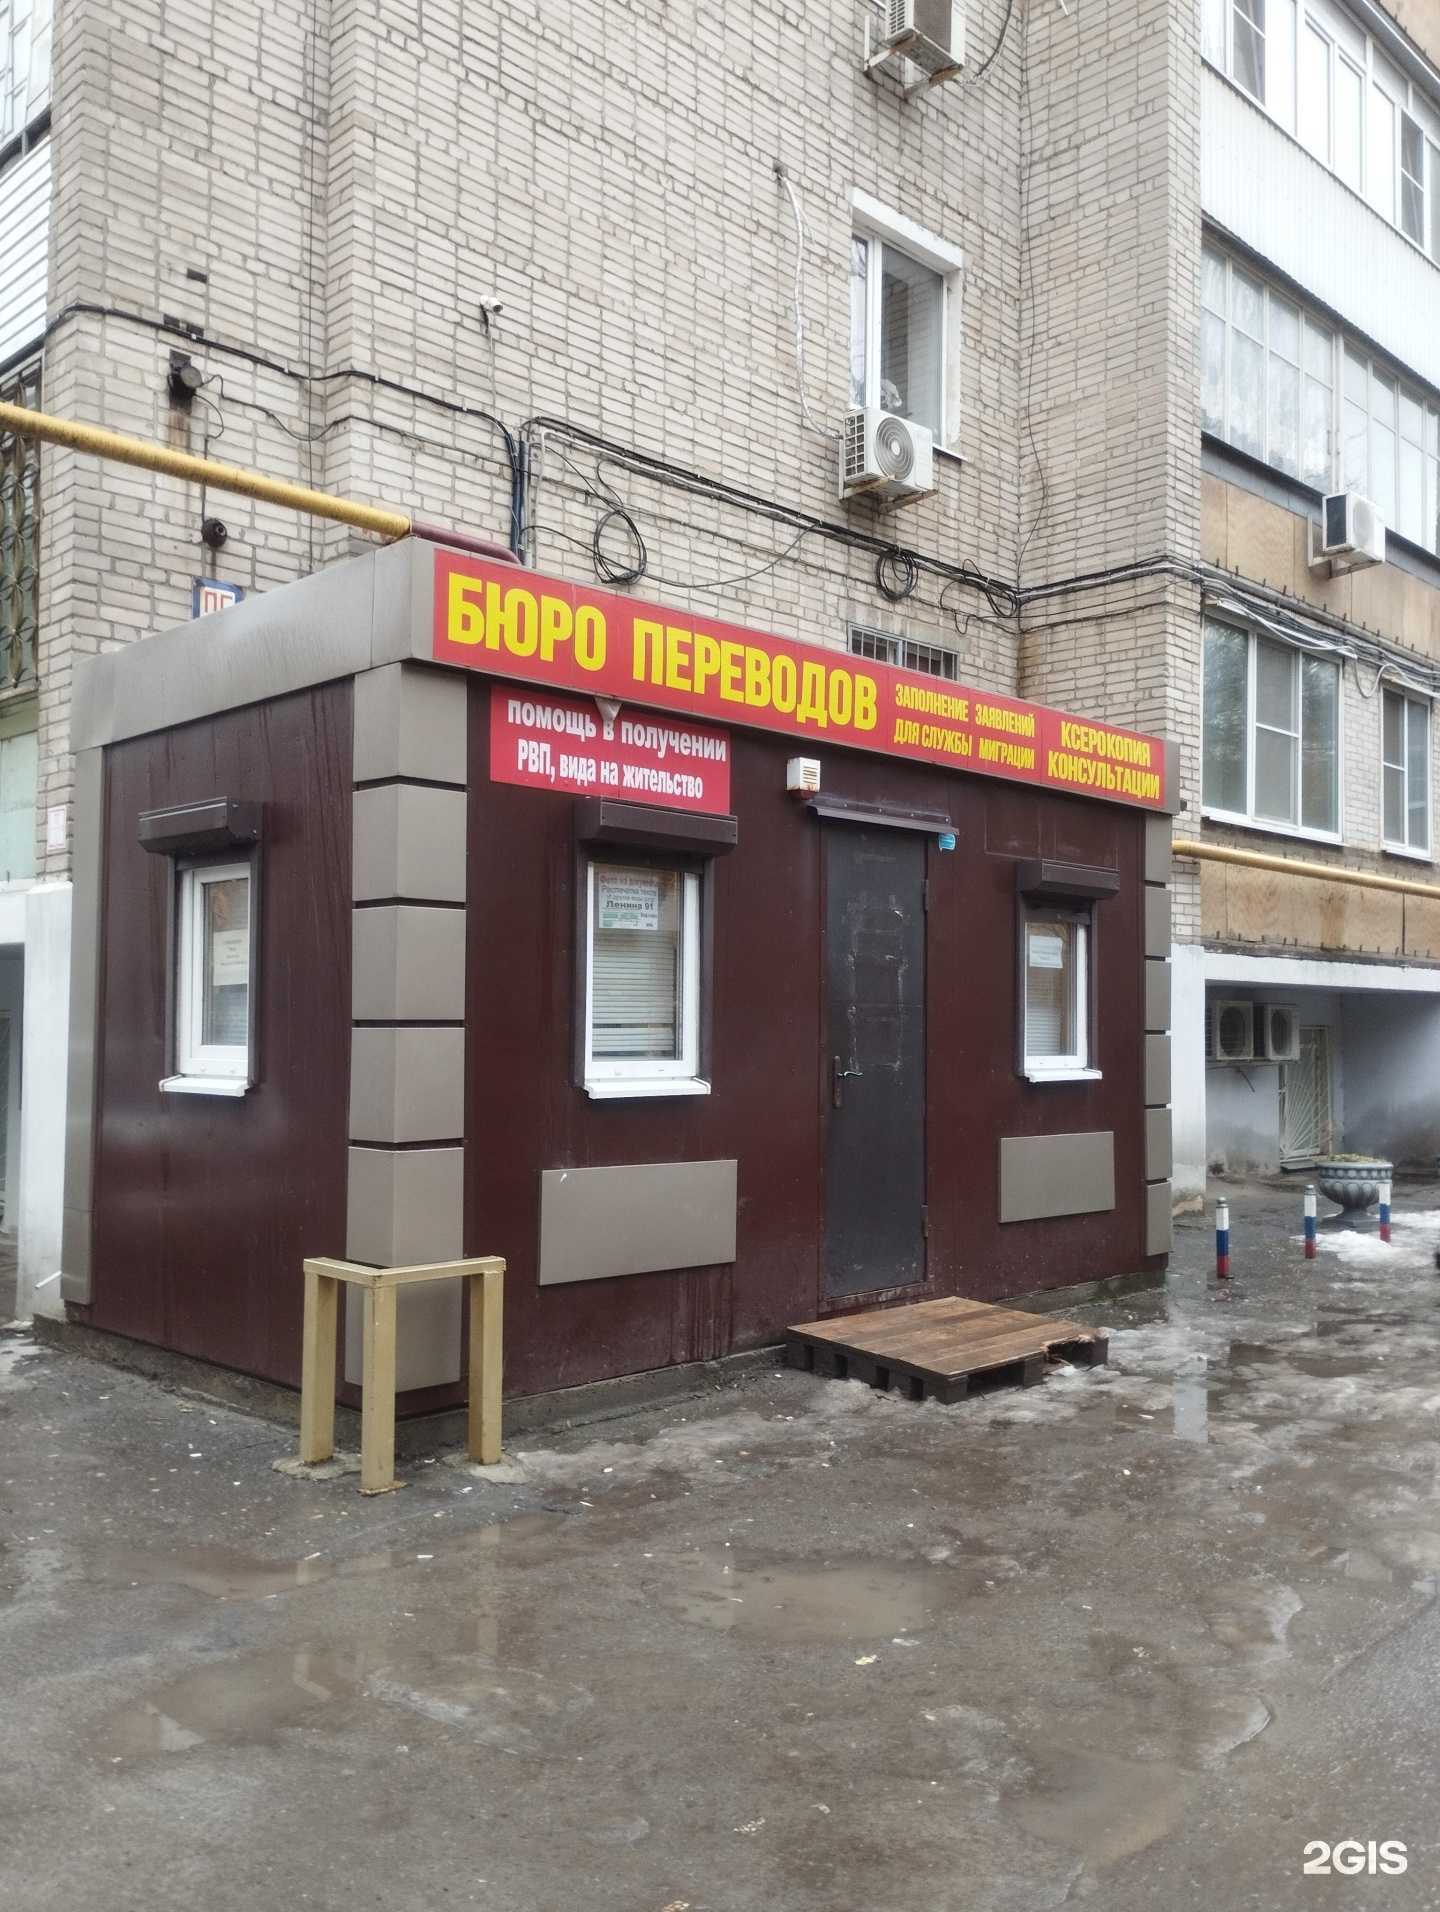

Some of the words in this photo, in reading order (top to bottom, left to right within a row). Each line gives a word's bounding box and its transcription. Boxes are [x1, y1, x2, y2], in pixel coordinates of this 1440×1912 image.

[448, 571, 607, 672] БЮРО
[632, 617, 878, 731] ПЕРЕВОДОВ
[507, 699, 597, 742] помощь
[603, 718, 615, 741] в
[620, 720, 727, 762] получении
[895, 683, 969, 722] ЗАПОЛНЕНИЕ
[975, 703, 1036, 738] ЗАЯВЛЕНИЙ
[517, 738, 556, 783] РВП,
[559, 753, 597, 787] вида
[600, 760, 619, 786] на
[622, 763, 703, 799] жительство
[893, 718, 920, 745] ДЛЯ
[921, 724, 973, 757] СЛУЖБЫ
[978, 737, 1036, 770] МИГРАЦИИ
[1047, 750, 1160, 800] КОНСУЛЬТАЦИИ
